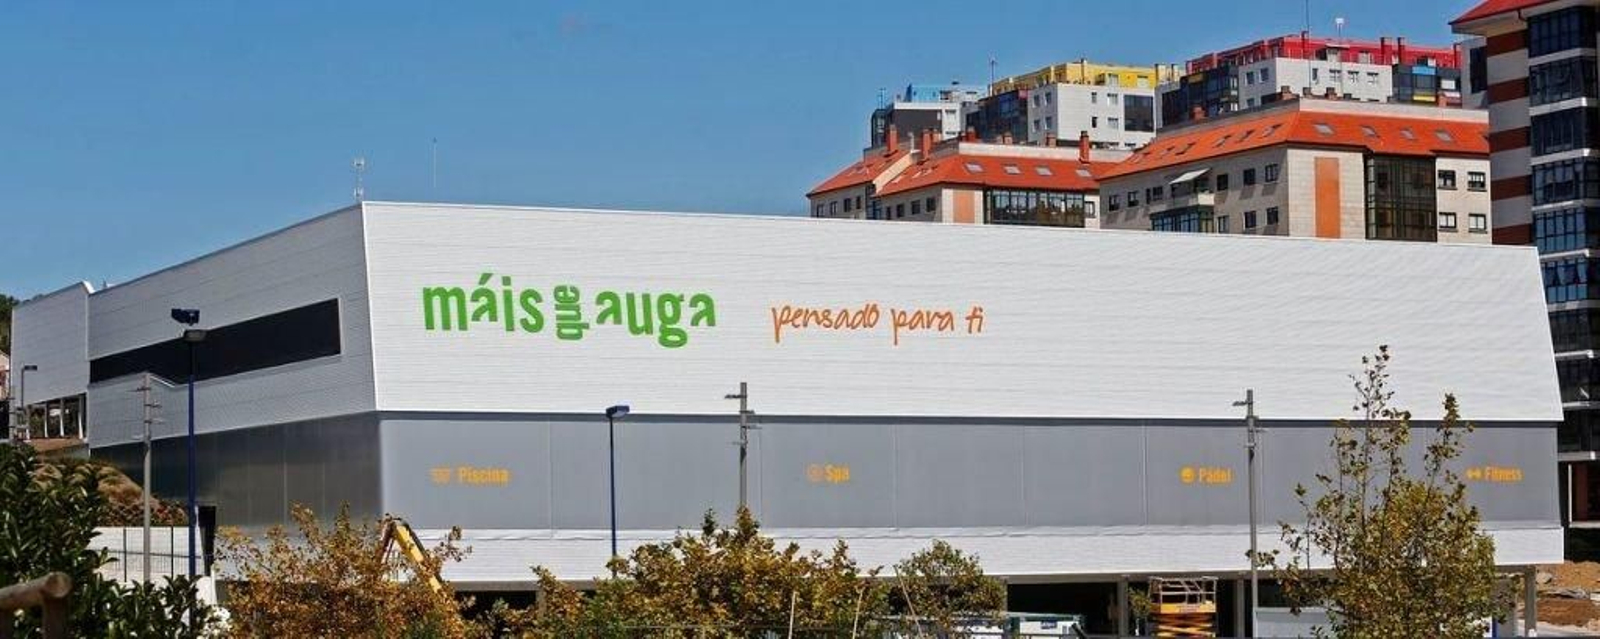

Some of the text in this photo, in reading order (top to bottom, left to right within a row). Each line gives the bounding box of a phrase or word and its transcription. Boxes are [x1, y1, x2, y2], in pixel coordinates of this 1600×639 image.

[421, 272, 717, 349] máis que auga
[771, 303, 984, 346] pensado para ti
[457, 466, 509, 485] Piscina
[824, 464, 850, 484] Spa
[1485, 466, 1522, 482] Fitness
